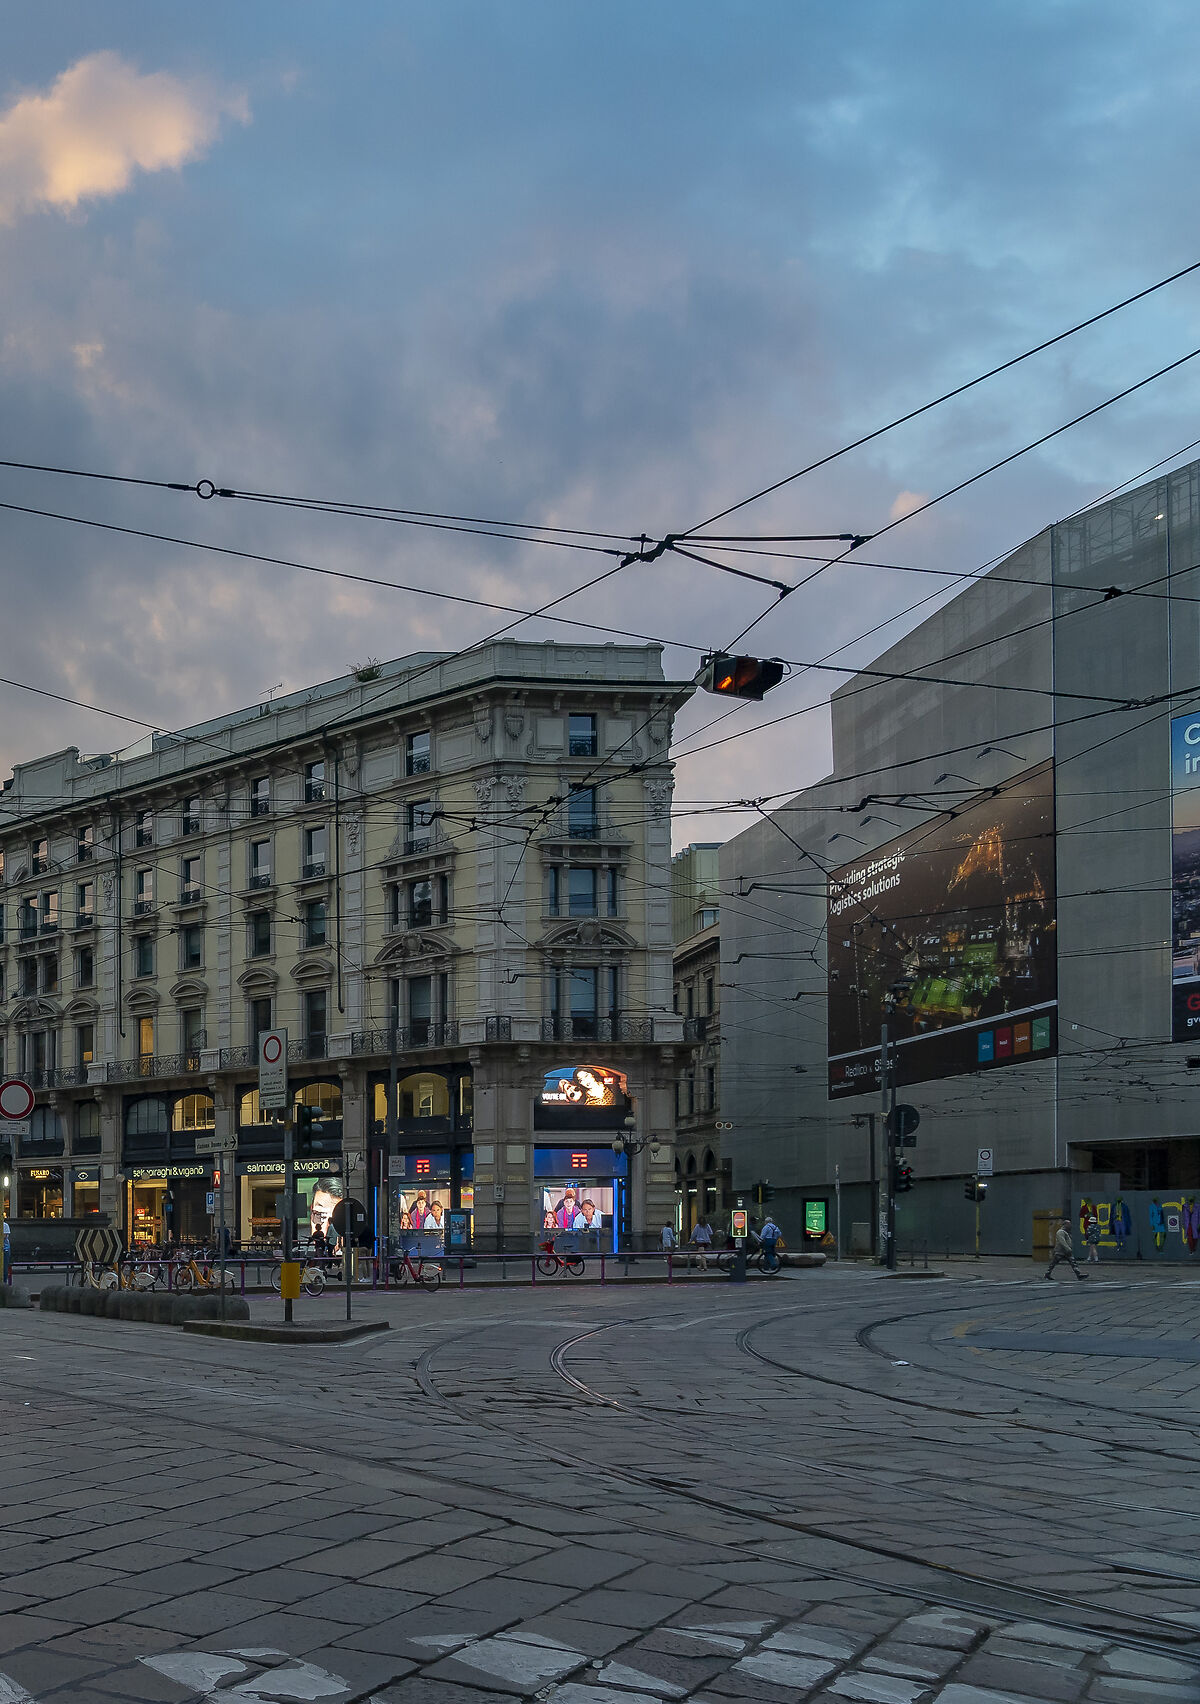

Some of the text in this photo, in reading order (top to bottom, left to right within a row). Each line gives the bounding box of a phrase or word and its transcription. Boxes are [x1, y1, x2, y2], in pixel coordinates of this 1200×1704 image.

[829, 848, 906, 895] Providing strategic
[830, 873, 901, 916] logistics solutions
